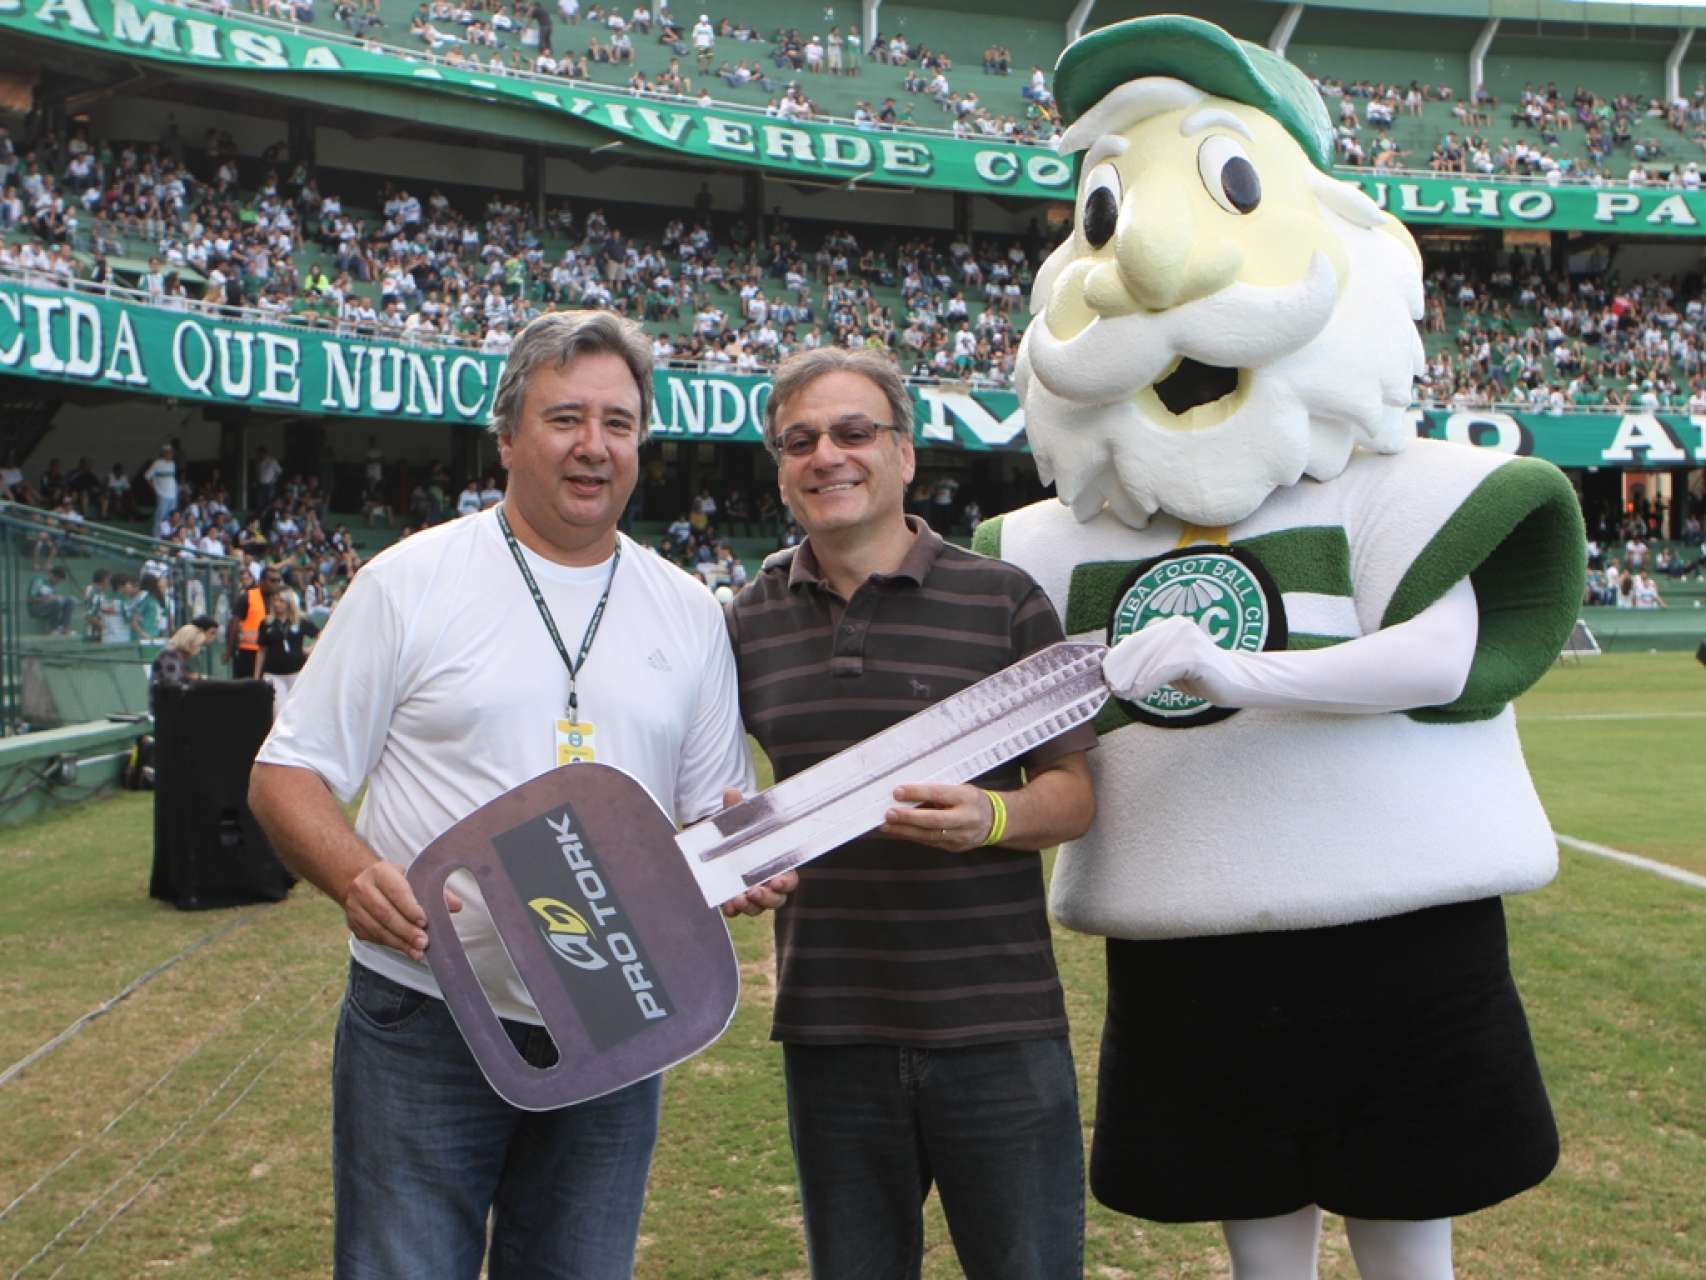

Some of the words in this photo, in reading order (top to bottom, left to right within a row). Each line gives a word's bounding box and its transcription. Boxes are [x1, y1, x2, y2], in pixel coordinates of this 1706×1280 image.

[0, 0, 343, 70] AMISA
[1594, 192, 1697, 225] PA
[172, 319, 300, 404] QUE
[545, 812, 617, 927] TORK
[606, 931, 668, 1020] PRO
